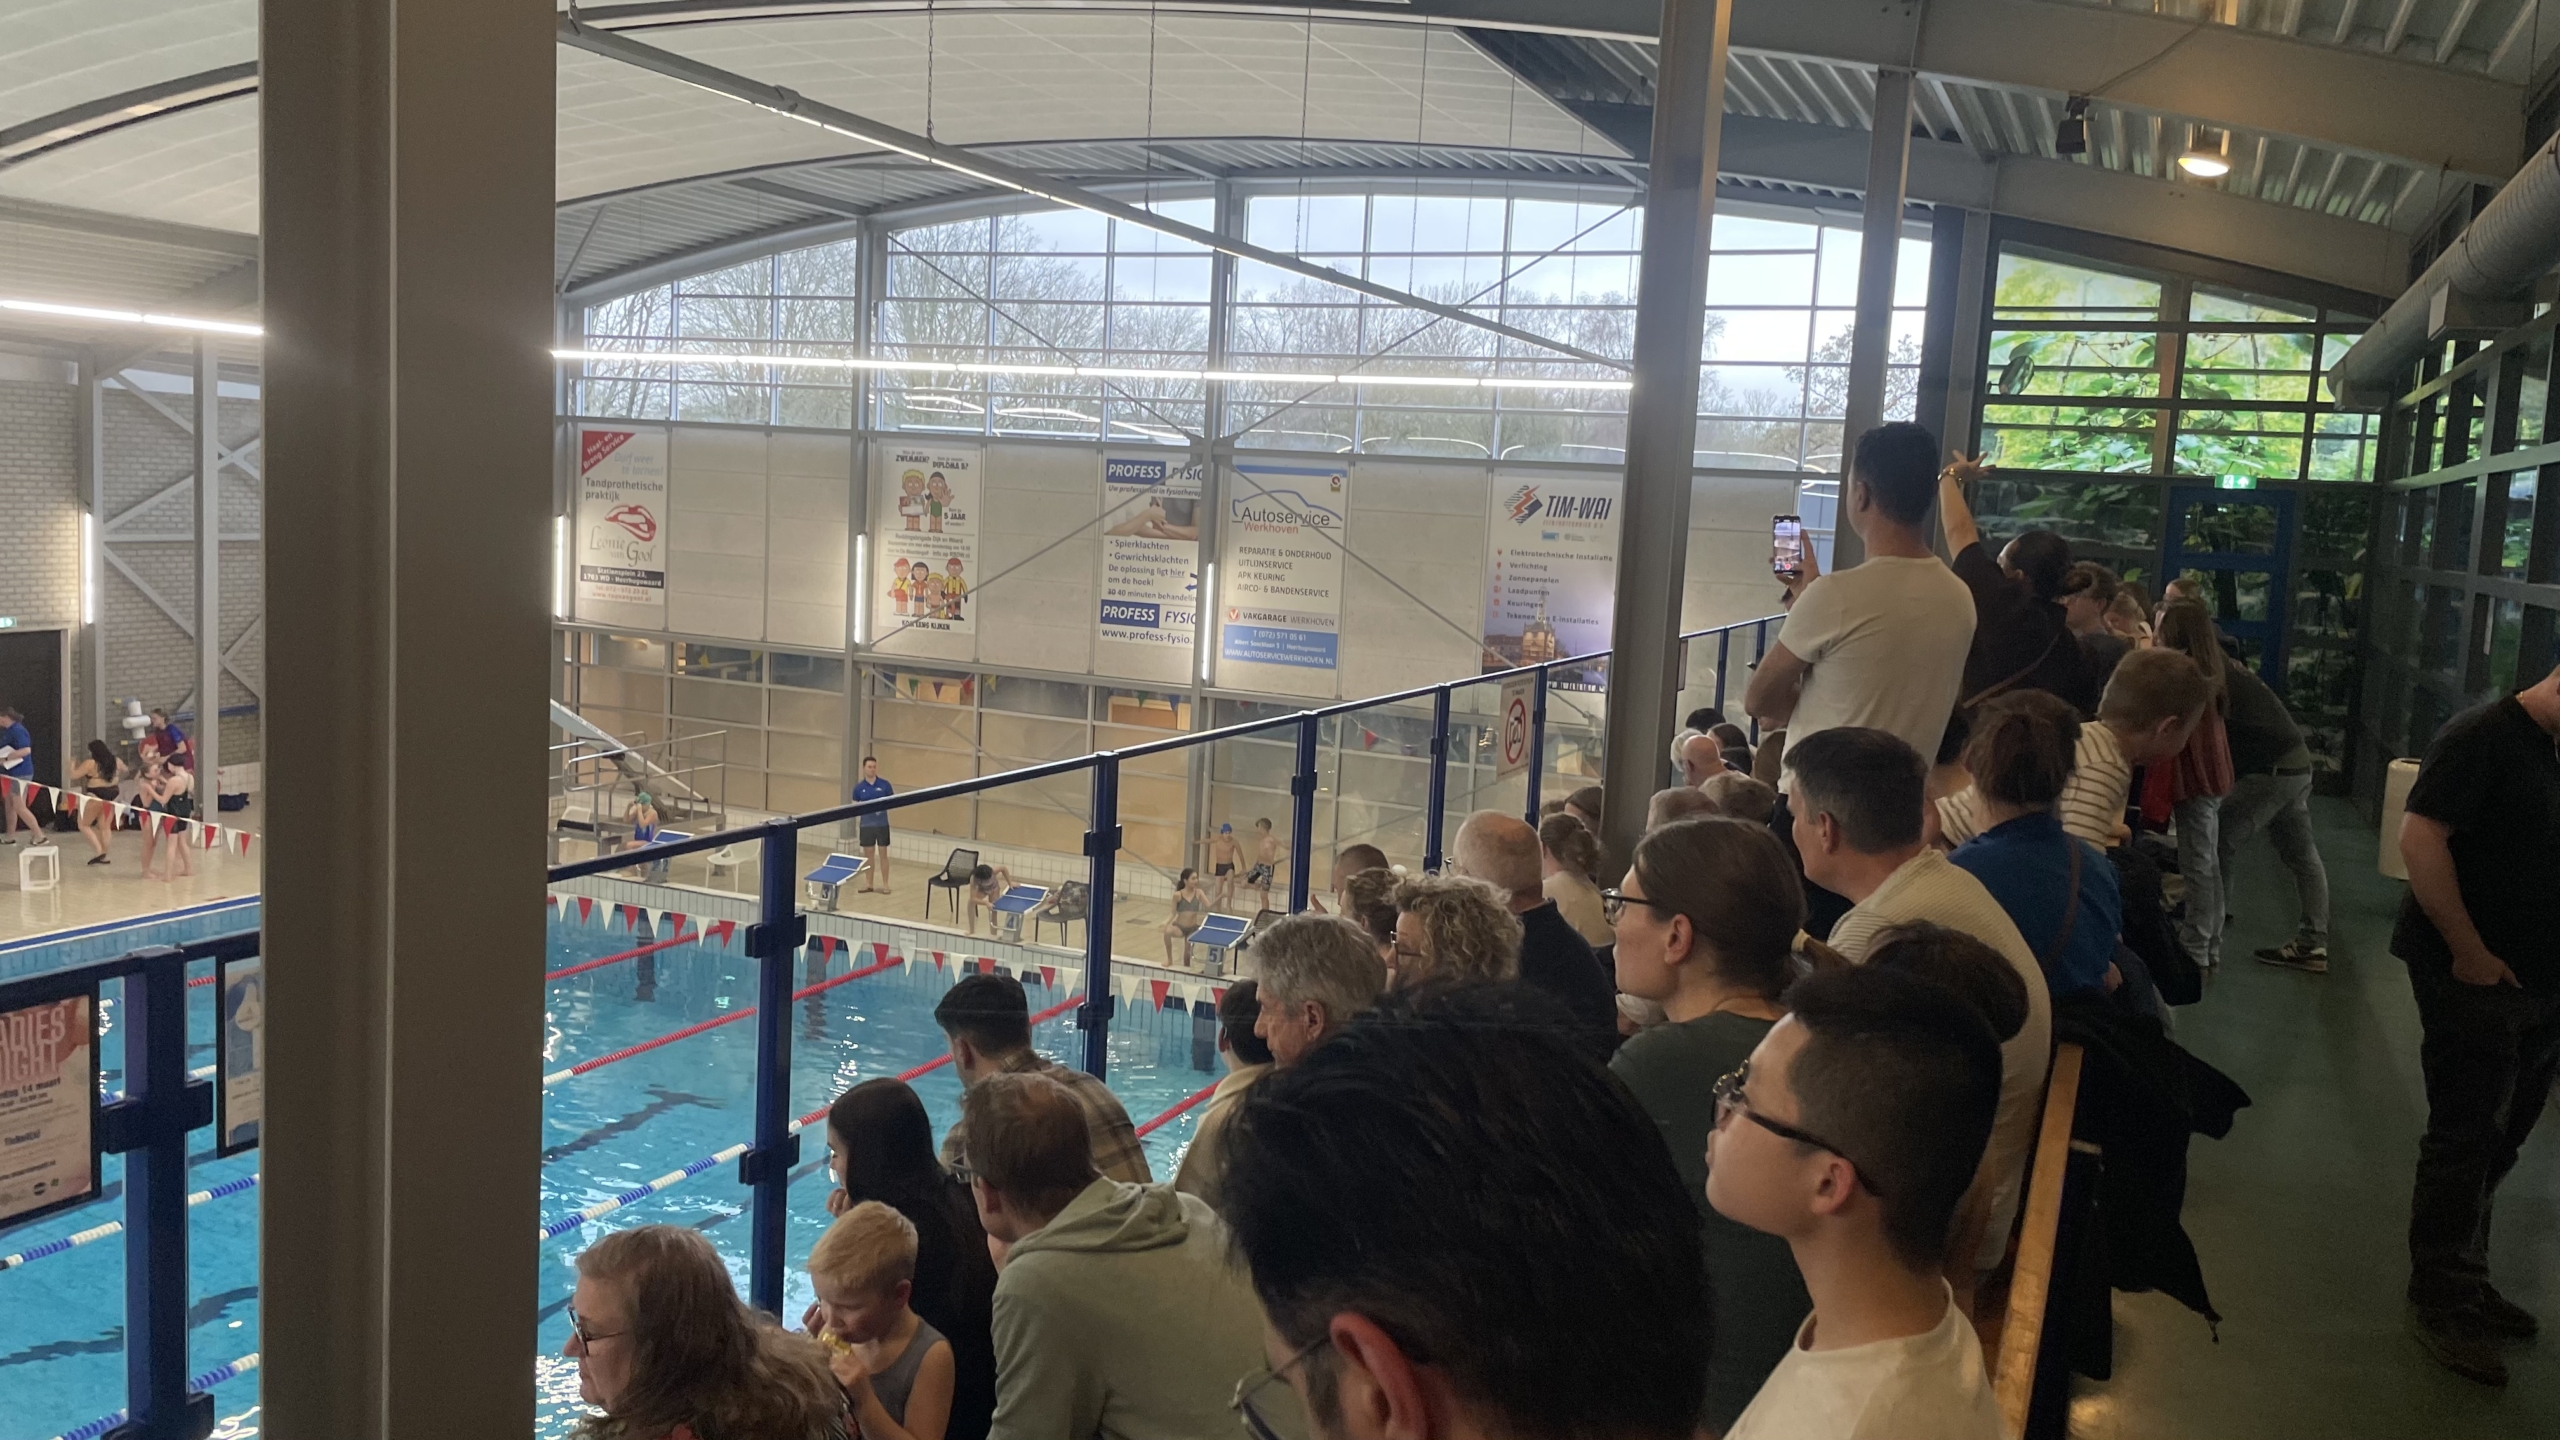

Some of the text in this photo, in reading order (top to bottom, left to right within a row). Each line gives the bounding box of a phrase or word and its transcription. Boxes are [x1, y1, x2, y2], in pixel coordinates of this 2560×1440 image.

[604, 433, 613, 442] en
[583, 434, 624, 469] Breng Service
[896, 455, 930, 463] ZWEMMEN?
[932, 461, 960, 469] DIPLOMA
[1108, 464, 1162, 479] PROFESS
[585, 477, 664, 491] Tandprothetische
[585, 490, 620, 502] praktijk
[1545, 495, 1613, 520] TIM-WAI
[1241, 506, 1330, 526] Autoservice
[1244, 522, 1299, 534] Werkhoven
[590, 525, 625, 550] Leonie
[1115, 539, 1170, 550] Spierklachten
[626, 541, 656, 567] Gool
[1114, 552, 1189, 565] Gewrichtsklachten
[1239, 546, 1332, 560] REPARATIE & ONDERHOUD
[1510, 549, 1574, 560] Elektrotechnische
[1108, 564, 1185, 577] De oplossing ligt hier
[1238, 559, 1293, 570] UITLIJNSERVICE
[1509, 562, 1548, 572] Verlichting
[1121, 576, 1131, 584] de
[1132, 577, 1154, 586] hoek!
[1238, 571, 1286, 582] APK KEURING
[1509, 574, 1560, 585] Zonnepanelen
[1117, 589, 1126, 597] 40
[1127, 590, 1156, 599] minuten
[1157, 593, 1196, 602] behandelin
[1237, 583, 1330, 598] AIRCO- & BANDENSERVICE
[1507, 587, 1550, 596] Laadpunten
[1507, 600, 1544, 609] Keuringen
[1102, 605, 1156, 621] PROFESS
[1243, 611, 1335, 627] VAKGARAGE WERKHOVEN
[1506, 612, 1536, 620] Tekenen
[931, 622, 950, 630] KIJKEN
[1101, 629, 1193, 645] www.profess-fysio.
[1253, 629, 1258, 637] T
[1258, 630, 1276, 639] (072)
[1276, 631, 1288, 640] 571
[1224, 648, 1335, 665] WWW.AUTOSERVICEWERKHOVEN.NL
[1006, 915, 1014, 929] 4
[1209, 948, 1218, 962] 5
[0, 1007, 66, 1050] ADIES
[0, 1038, 58, 1081] IGHT
